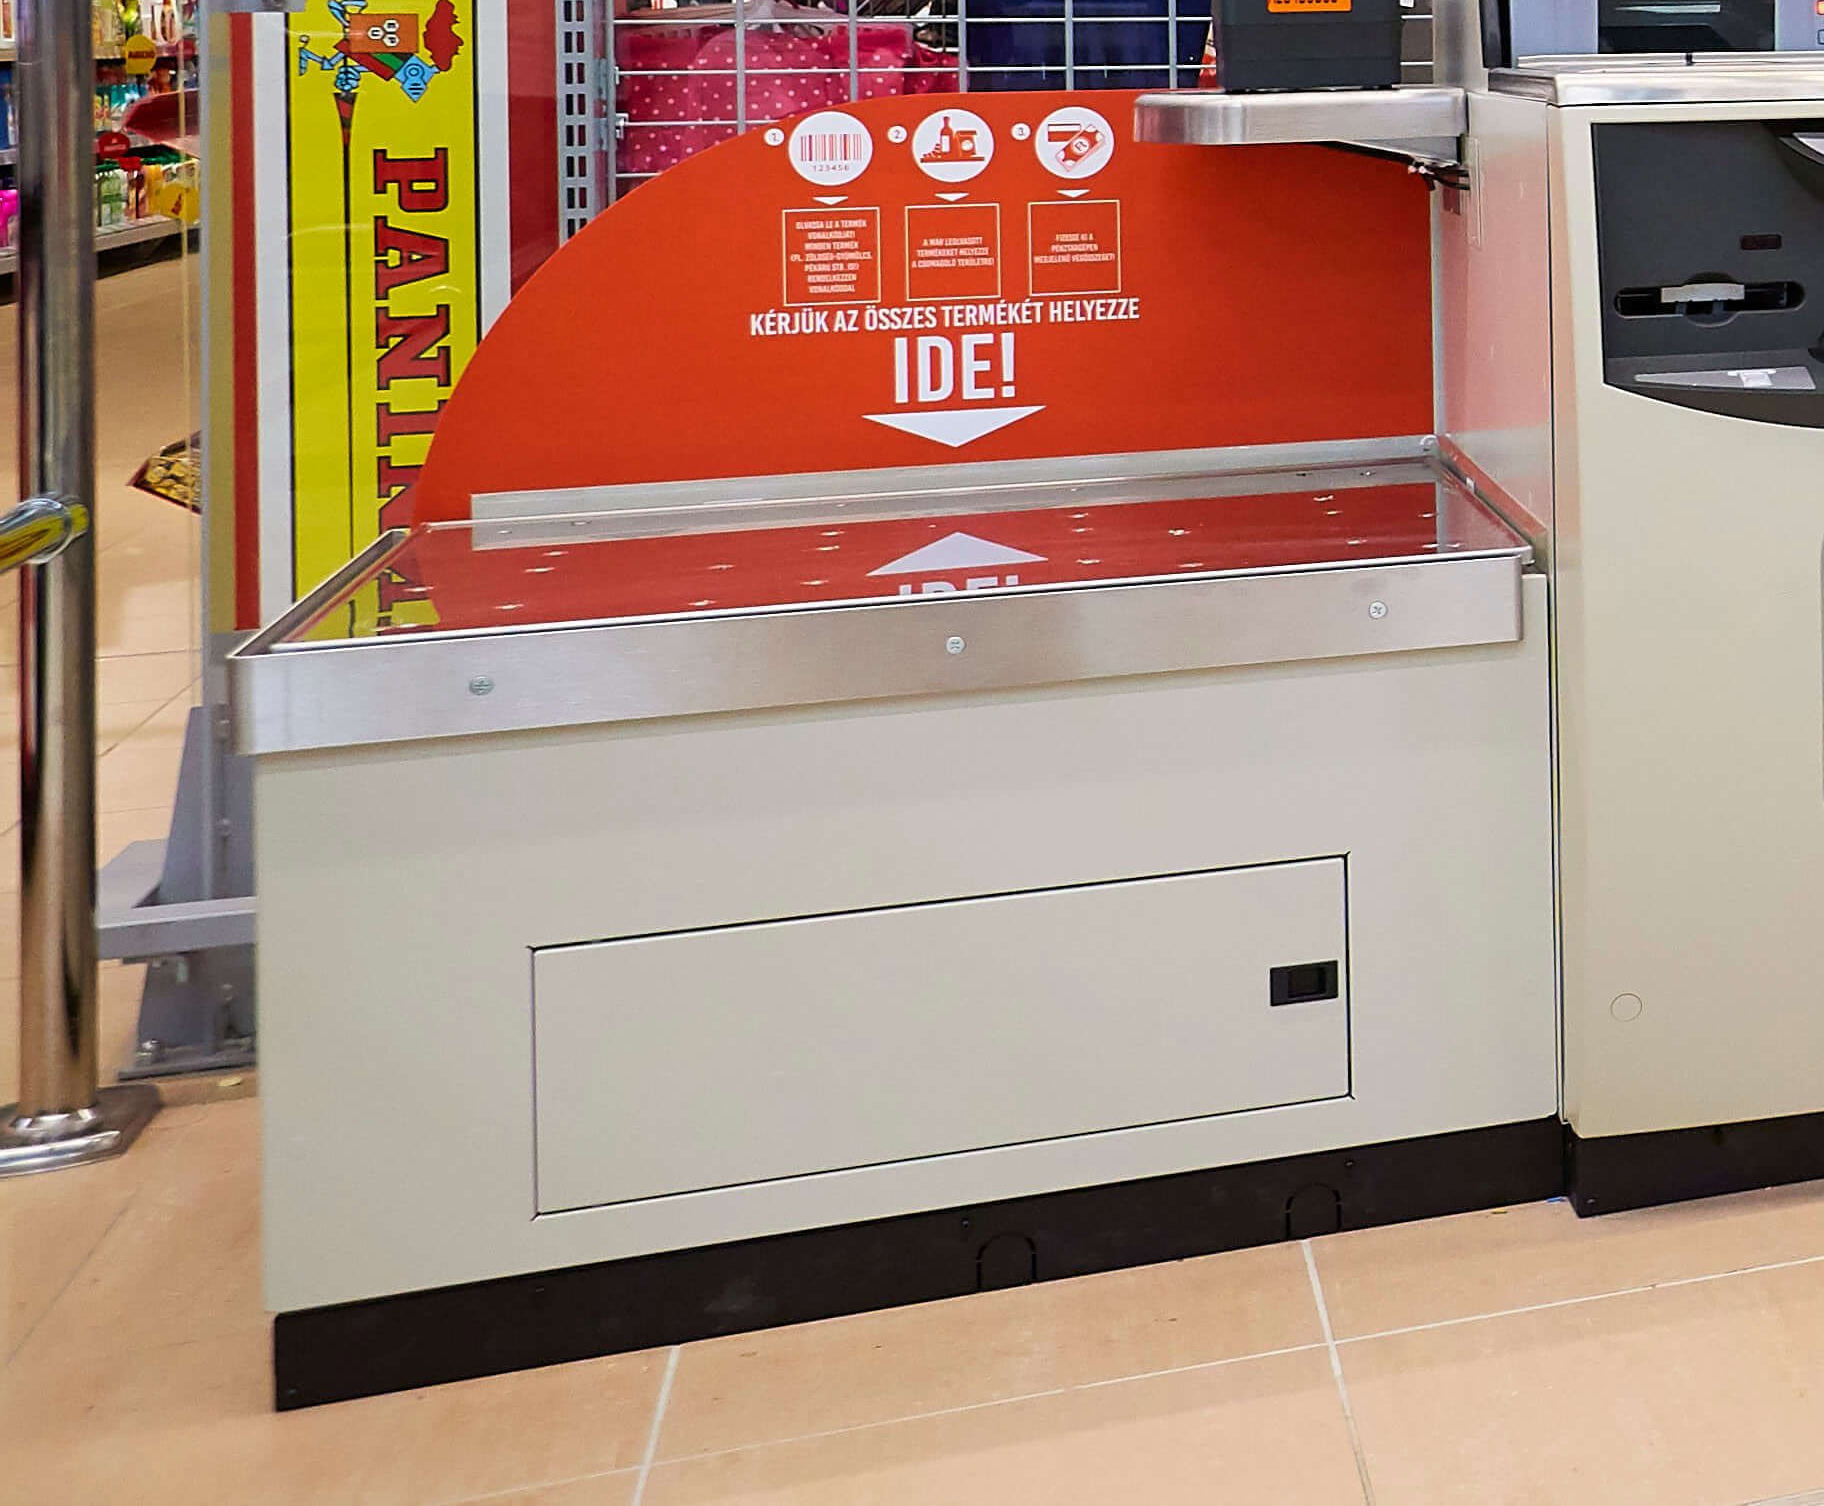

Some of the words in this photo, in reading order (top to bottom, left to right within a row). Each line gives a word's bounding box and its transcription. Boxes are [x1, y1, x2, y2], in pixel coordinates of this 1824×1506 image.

[812, 163, 851, 172] 123456
[750, 310, 829, 336] KÉRJÜK
[833, 309, 860, 333] AZ
[864, 303, 937, 331] ÖSSZES
[942, 299, 1044, 328] TERMÉKÉT
[1049, 297, 1140, 323] HELYEZZE
[894, 332, 1016, 404] IDE!
